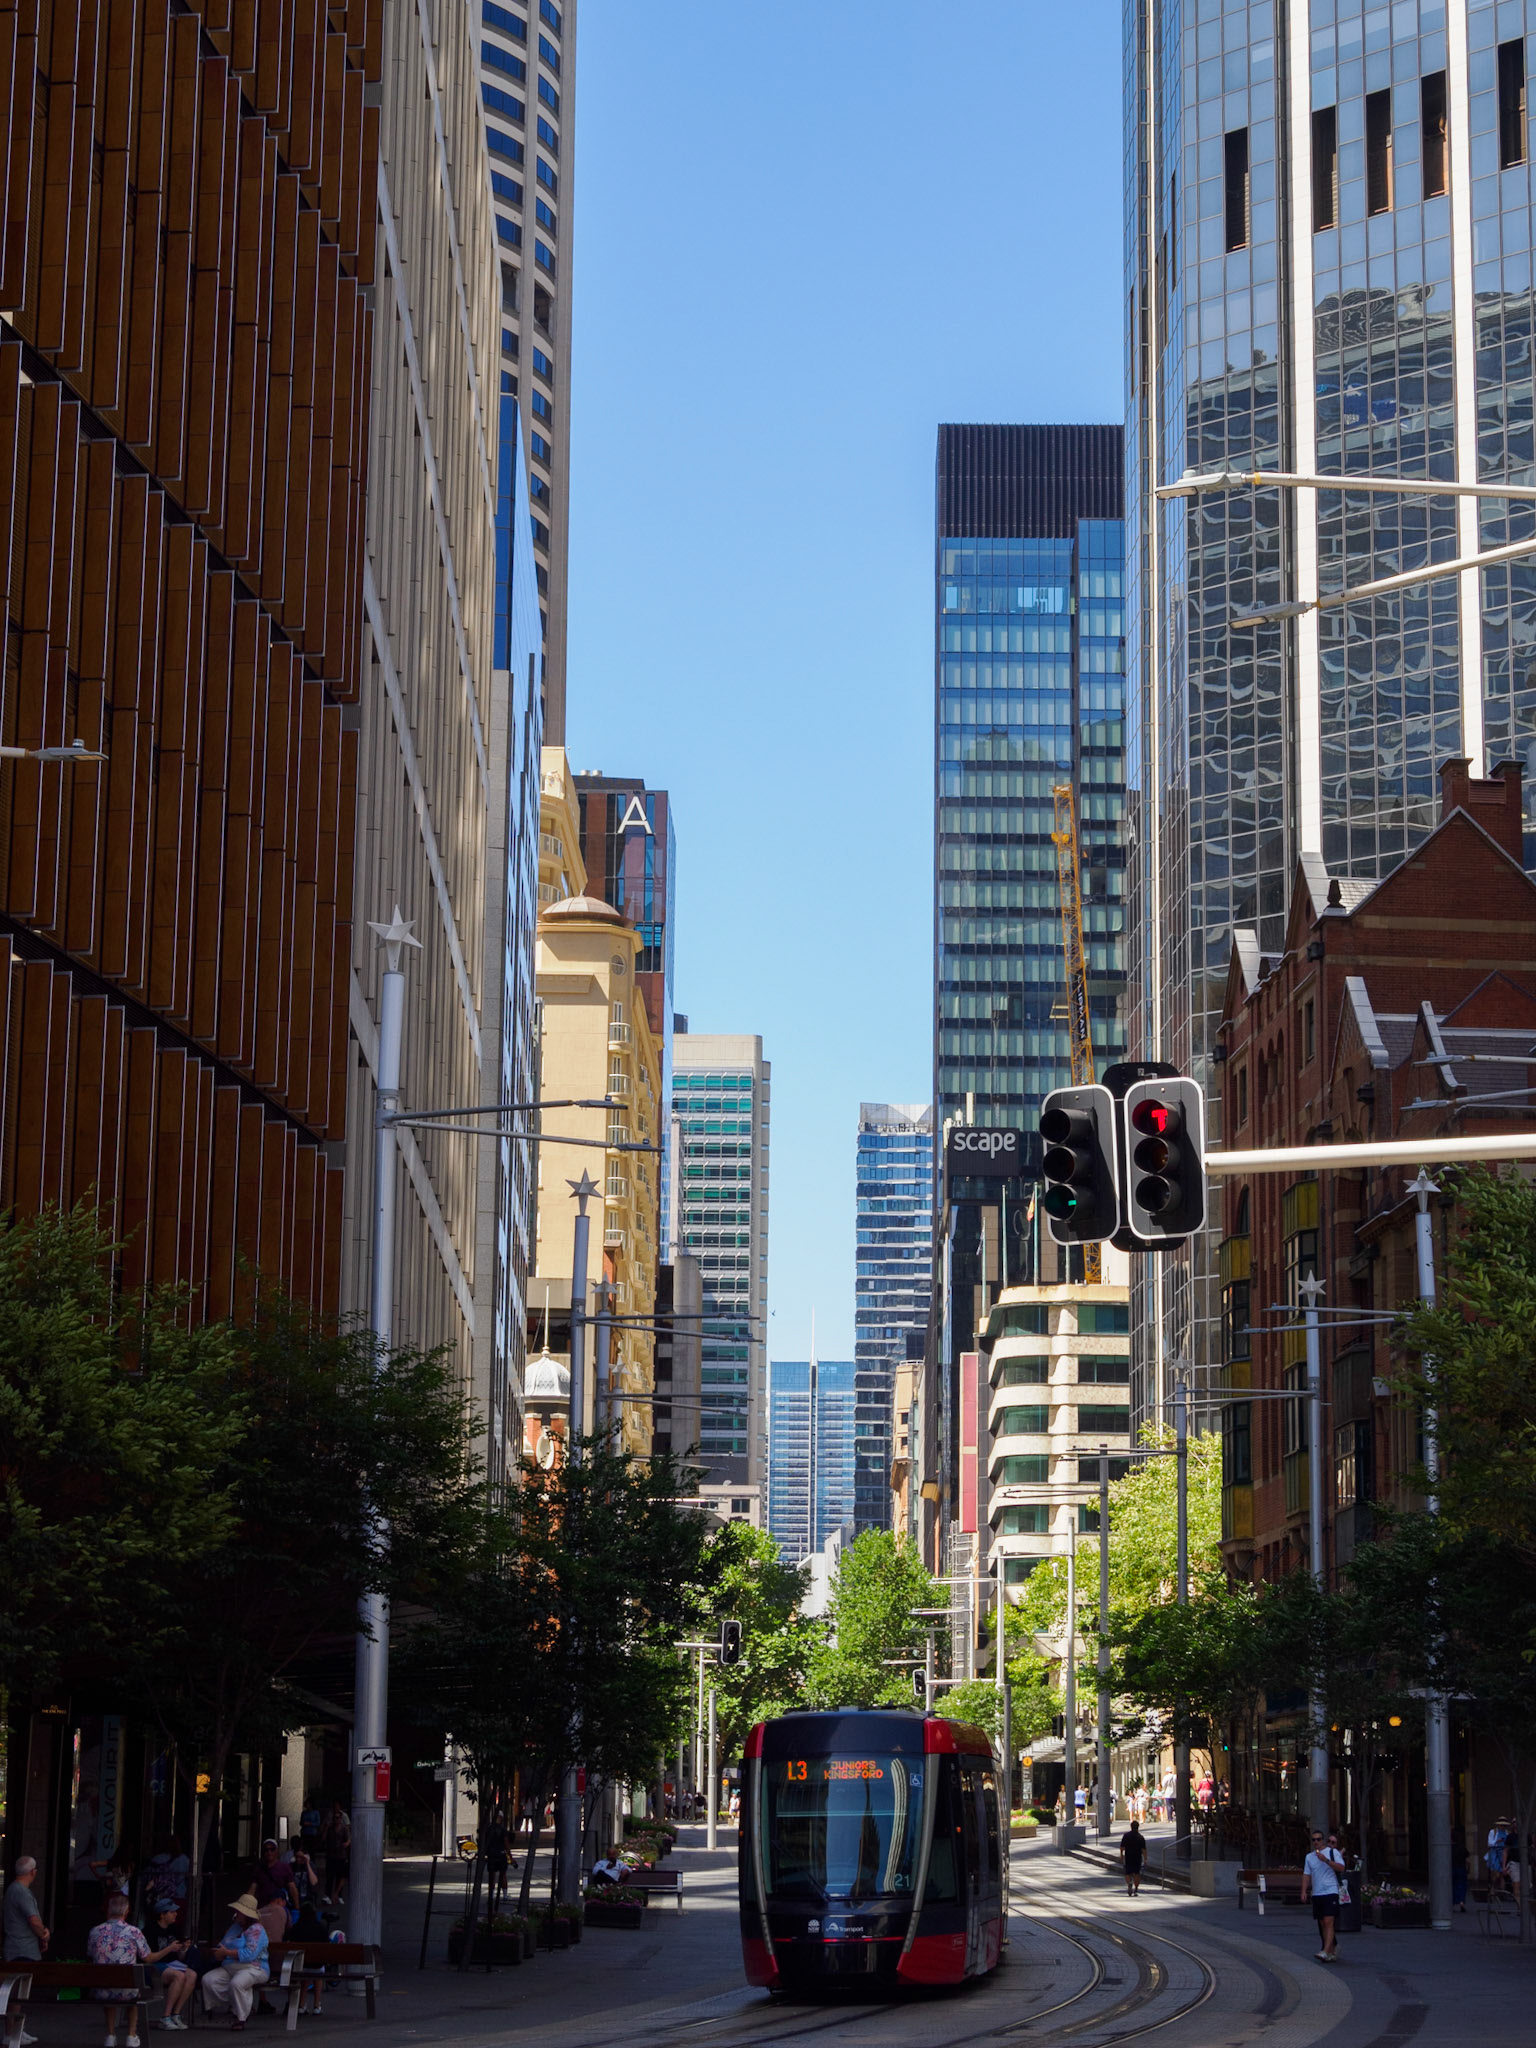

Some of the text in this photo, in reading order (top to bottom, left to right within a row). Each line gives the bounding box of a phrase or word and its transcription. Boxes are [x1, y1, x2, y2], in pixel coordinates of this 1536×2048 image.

[617, 796, 653, 834] A
[953, 1132, 1016, 1160] scape
[787, 1760, 808, 1781] L3
[823, 1769, 884, 1780] KINGSFORD
[831, 1760, 877, 1770] JUNIORS
[102, 1721, 119, 1850] SAVOUR IT
[894, 1873, 910, 1888] 21
